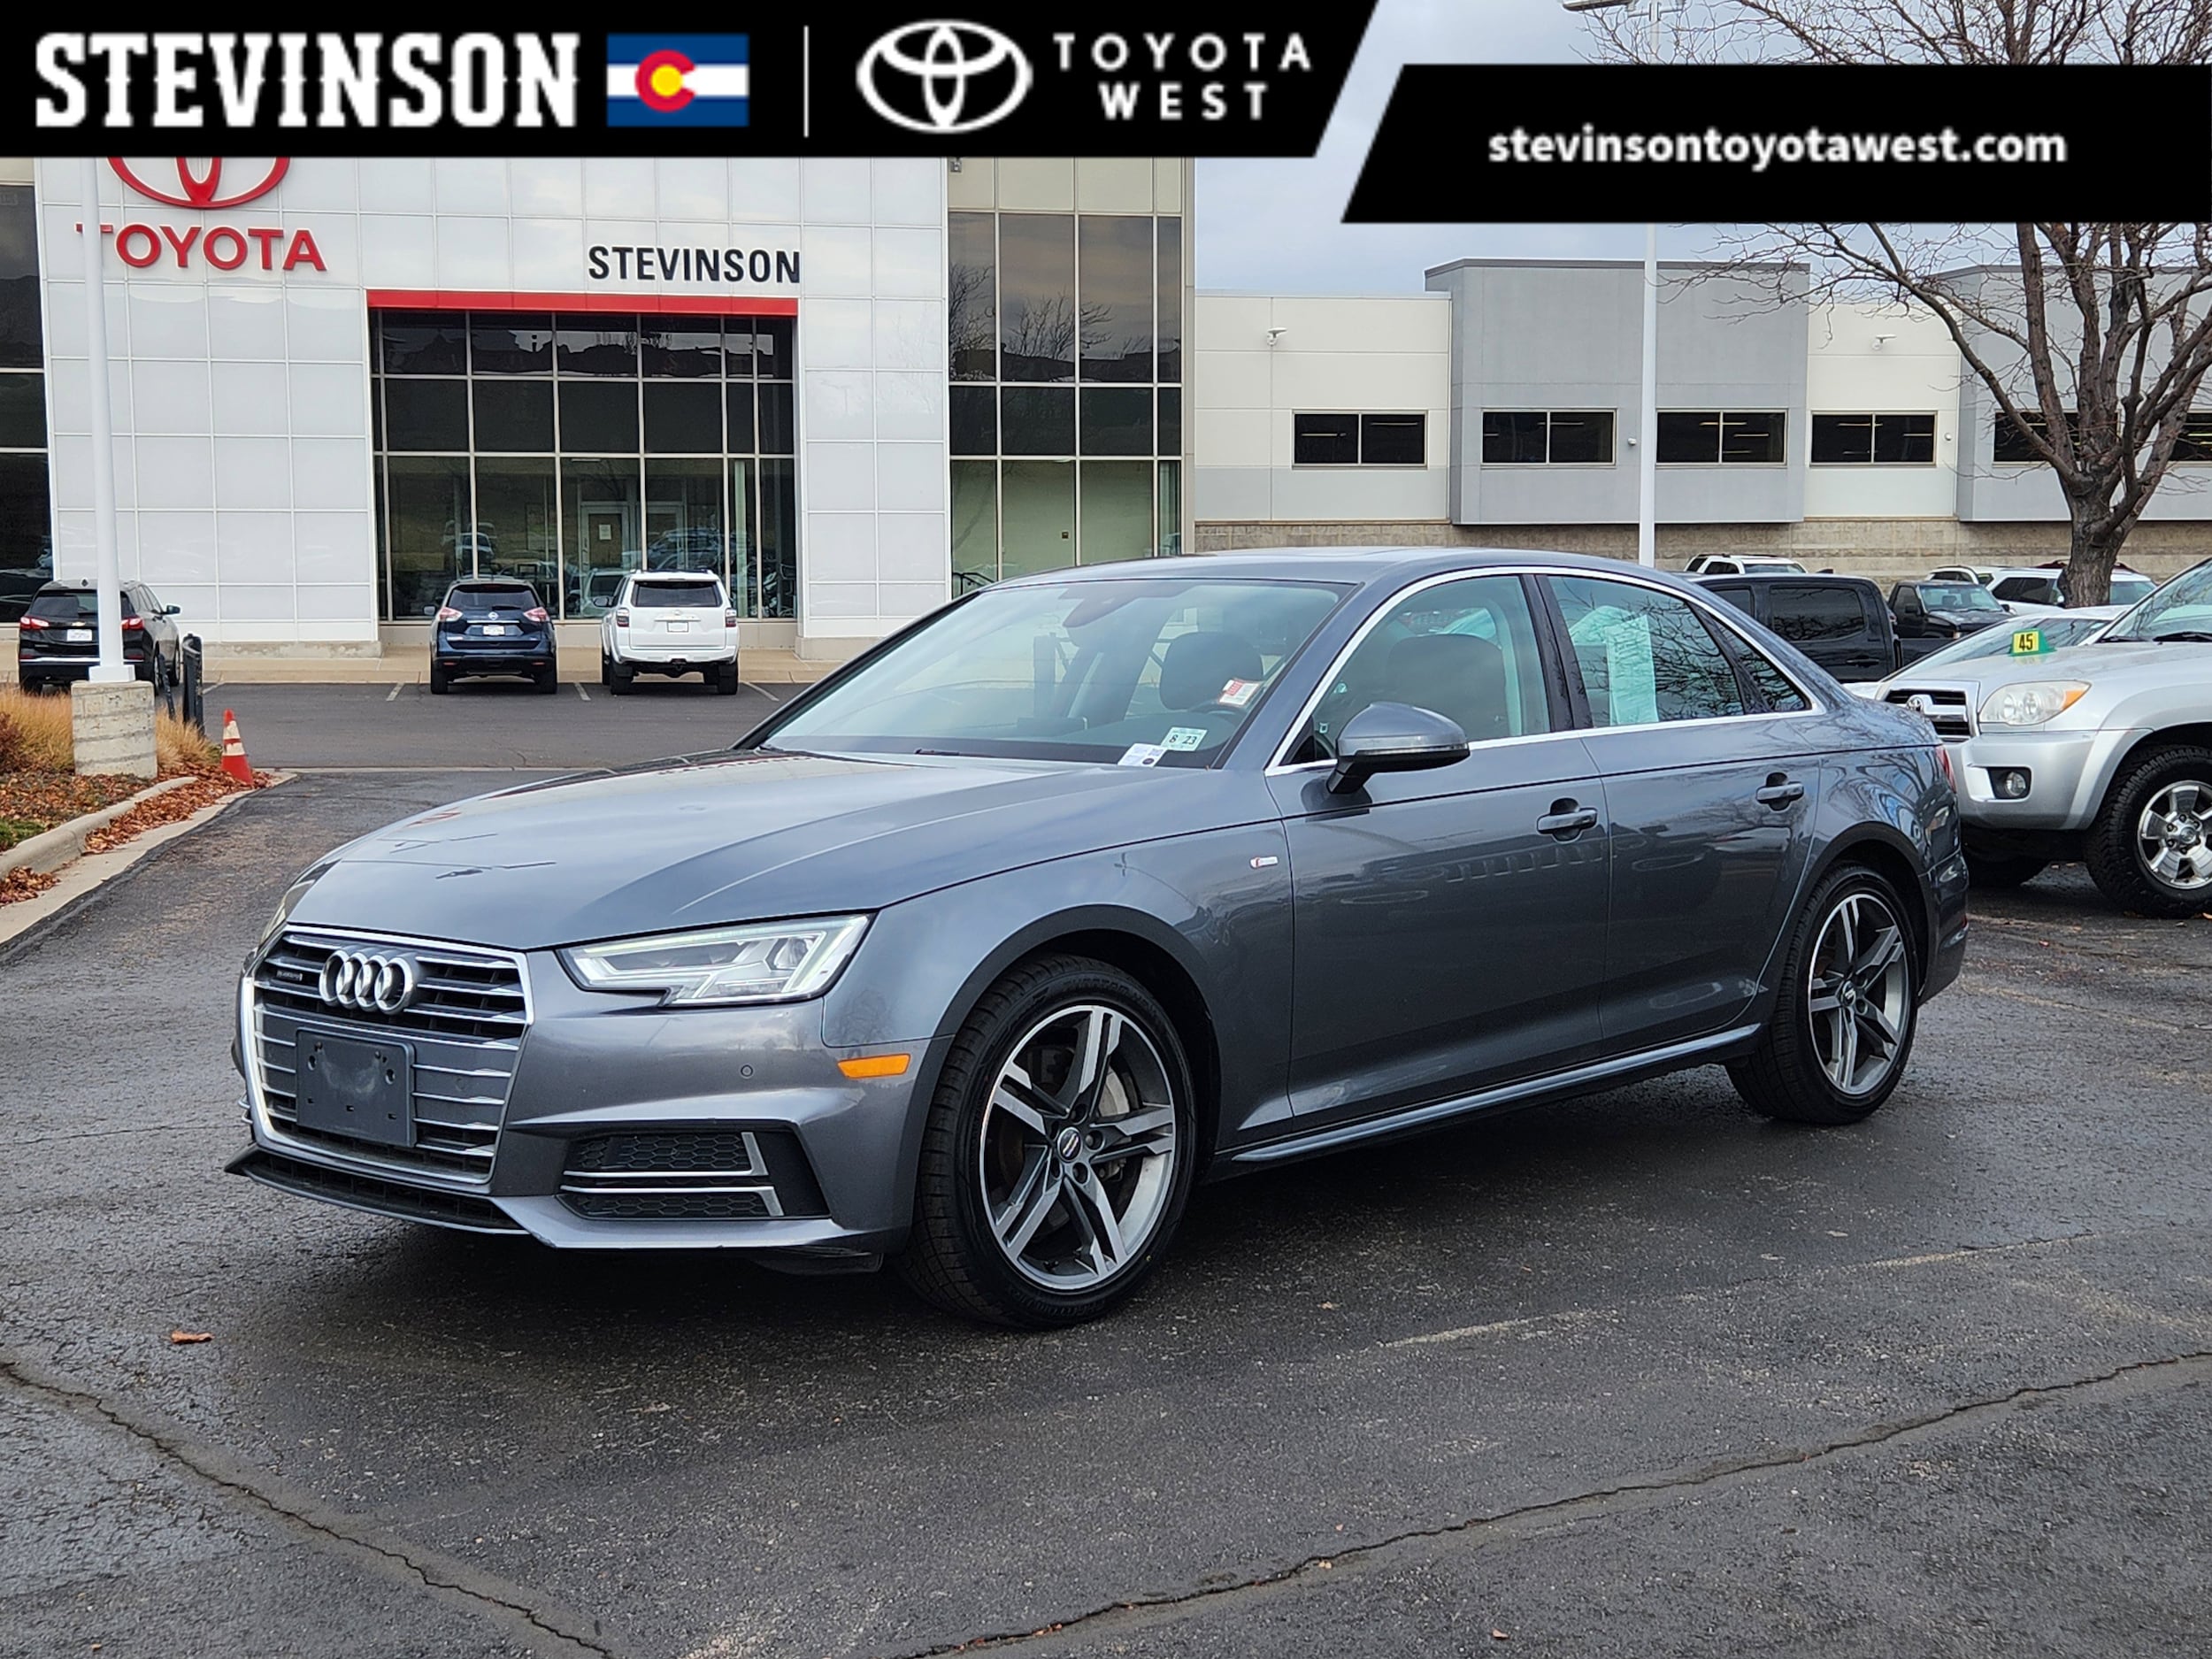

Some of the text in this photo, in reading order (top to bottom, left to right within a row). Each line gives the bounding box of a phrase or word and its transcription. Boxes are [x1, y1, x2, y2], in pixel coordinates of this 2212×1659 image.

[75, 223, 327, 272] OYOTA
[588, 246, 800, 283] STEVINSON
[2018, 634, 2033, 651] 45
[1181, 735, 1198, 745] 23
